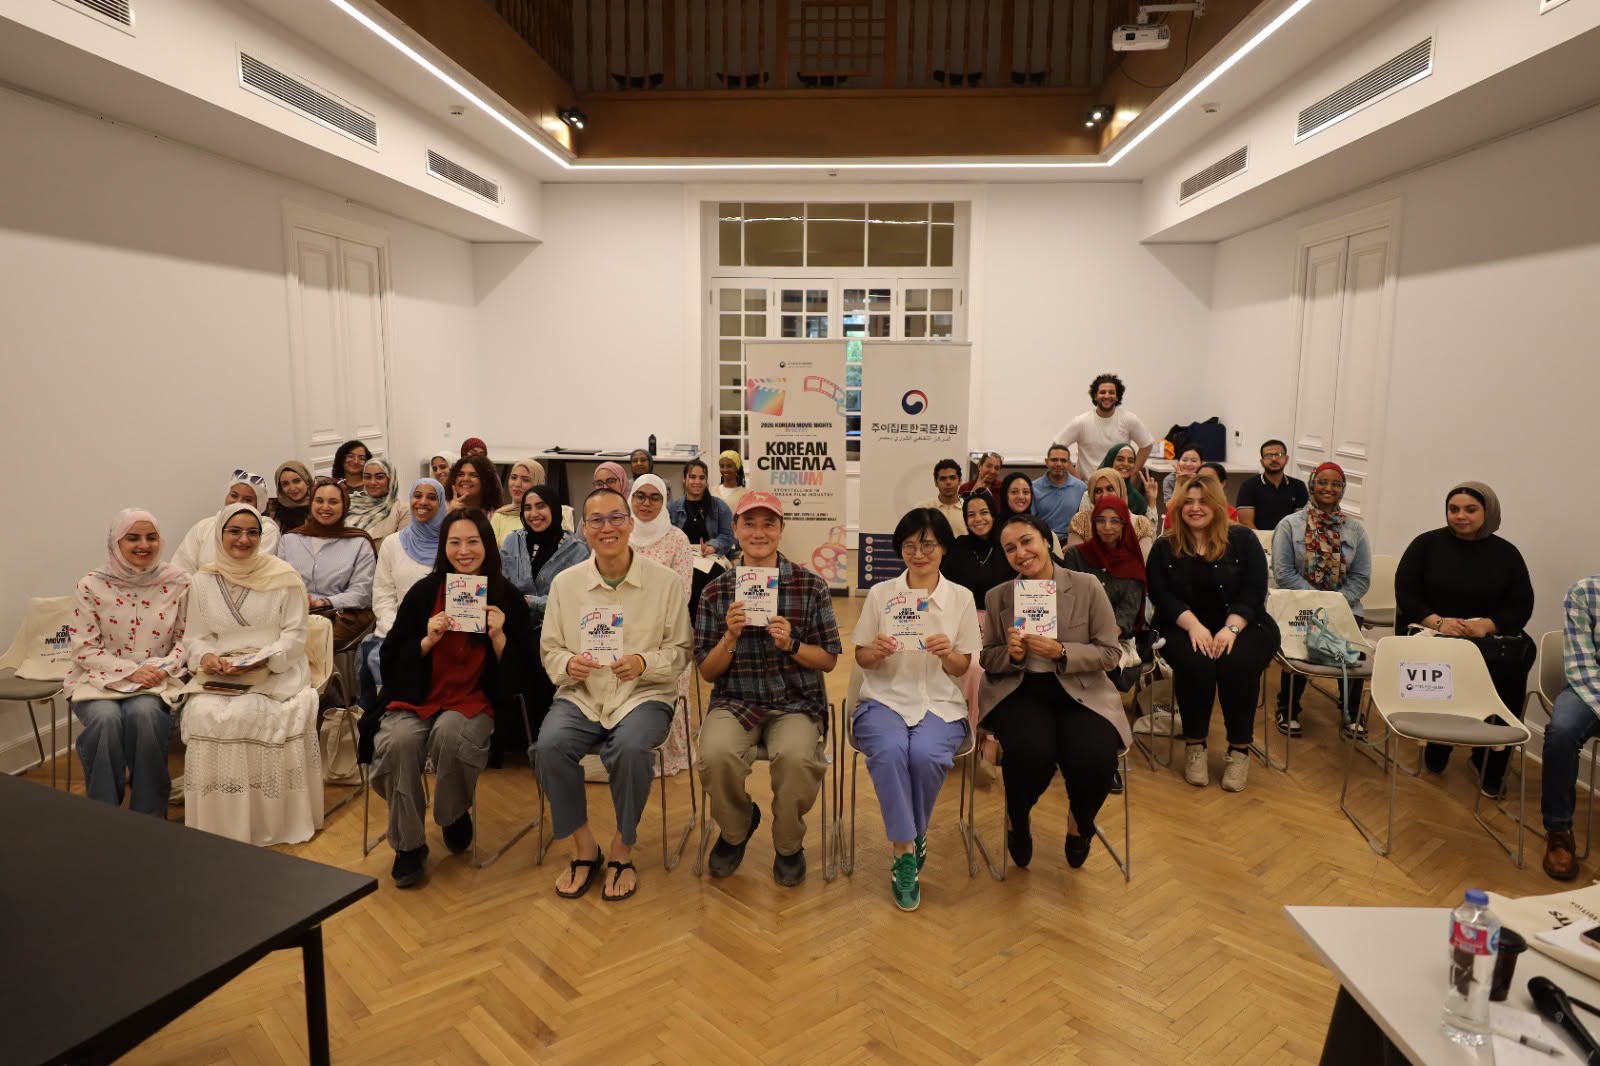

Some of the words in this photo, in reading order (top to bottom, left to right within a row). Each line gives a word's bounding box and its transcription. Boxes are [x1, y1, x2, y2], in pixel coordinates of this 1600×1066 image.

[871, 422, 958, 435] 주이집트한국문화원
[766, 441, 828, 456] KOREAN
[757, 456, 837, 471] CINEMA
[770, 471, 824, 486] FORUM
[1406, 669, 1443, 682] VIP
